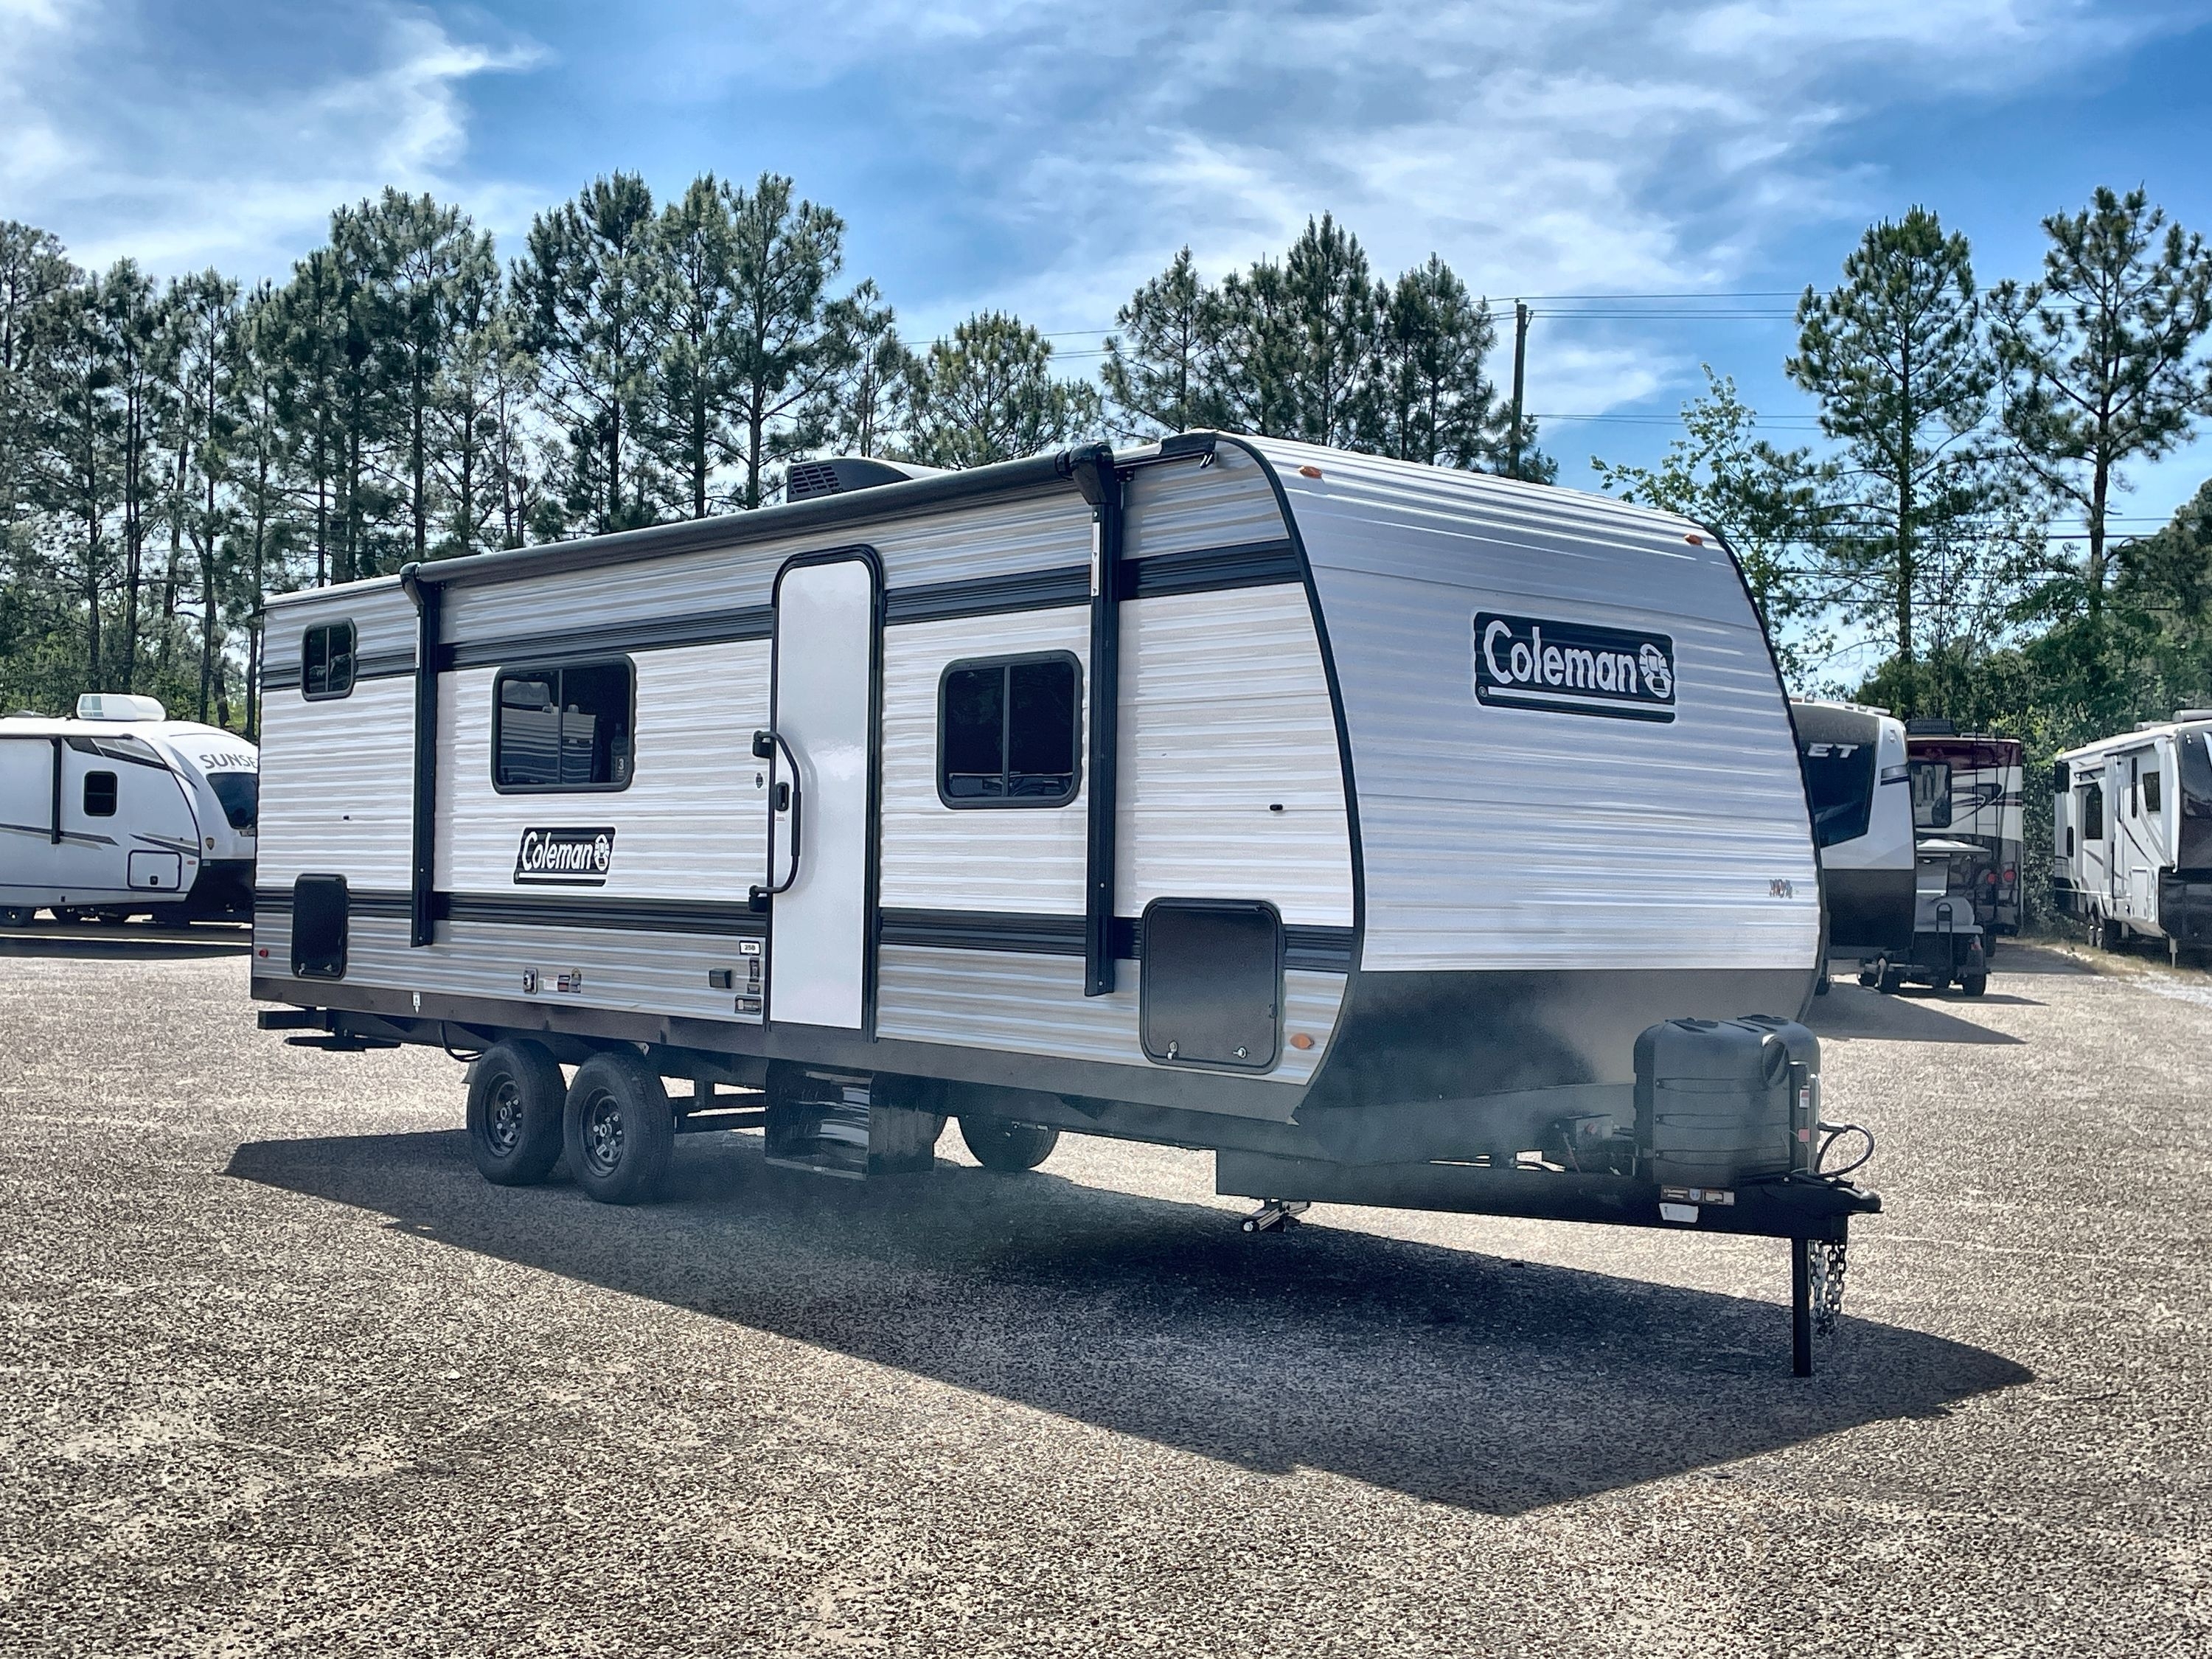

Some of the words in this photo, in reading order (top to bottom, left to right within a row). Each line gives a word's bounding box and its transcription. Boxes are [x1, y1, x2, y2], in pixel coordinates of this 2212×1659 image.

[1484, 619, 1638, 693] Coleman
[199, 753, 258, 769] SUNSE
[1802, 742, 1859, 758] ET
[522, 831, 593, 871] Coleman
